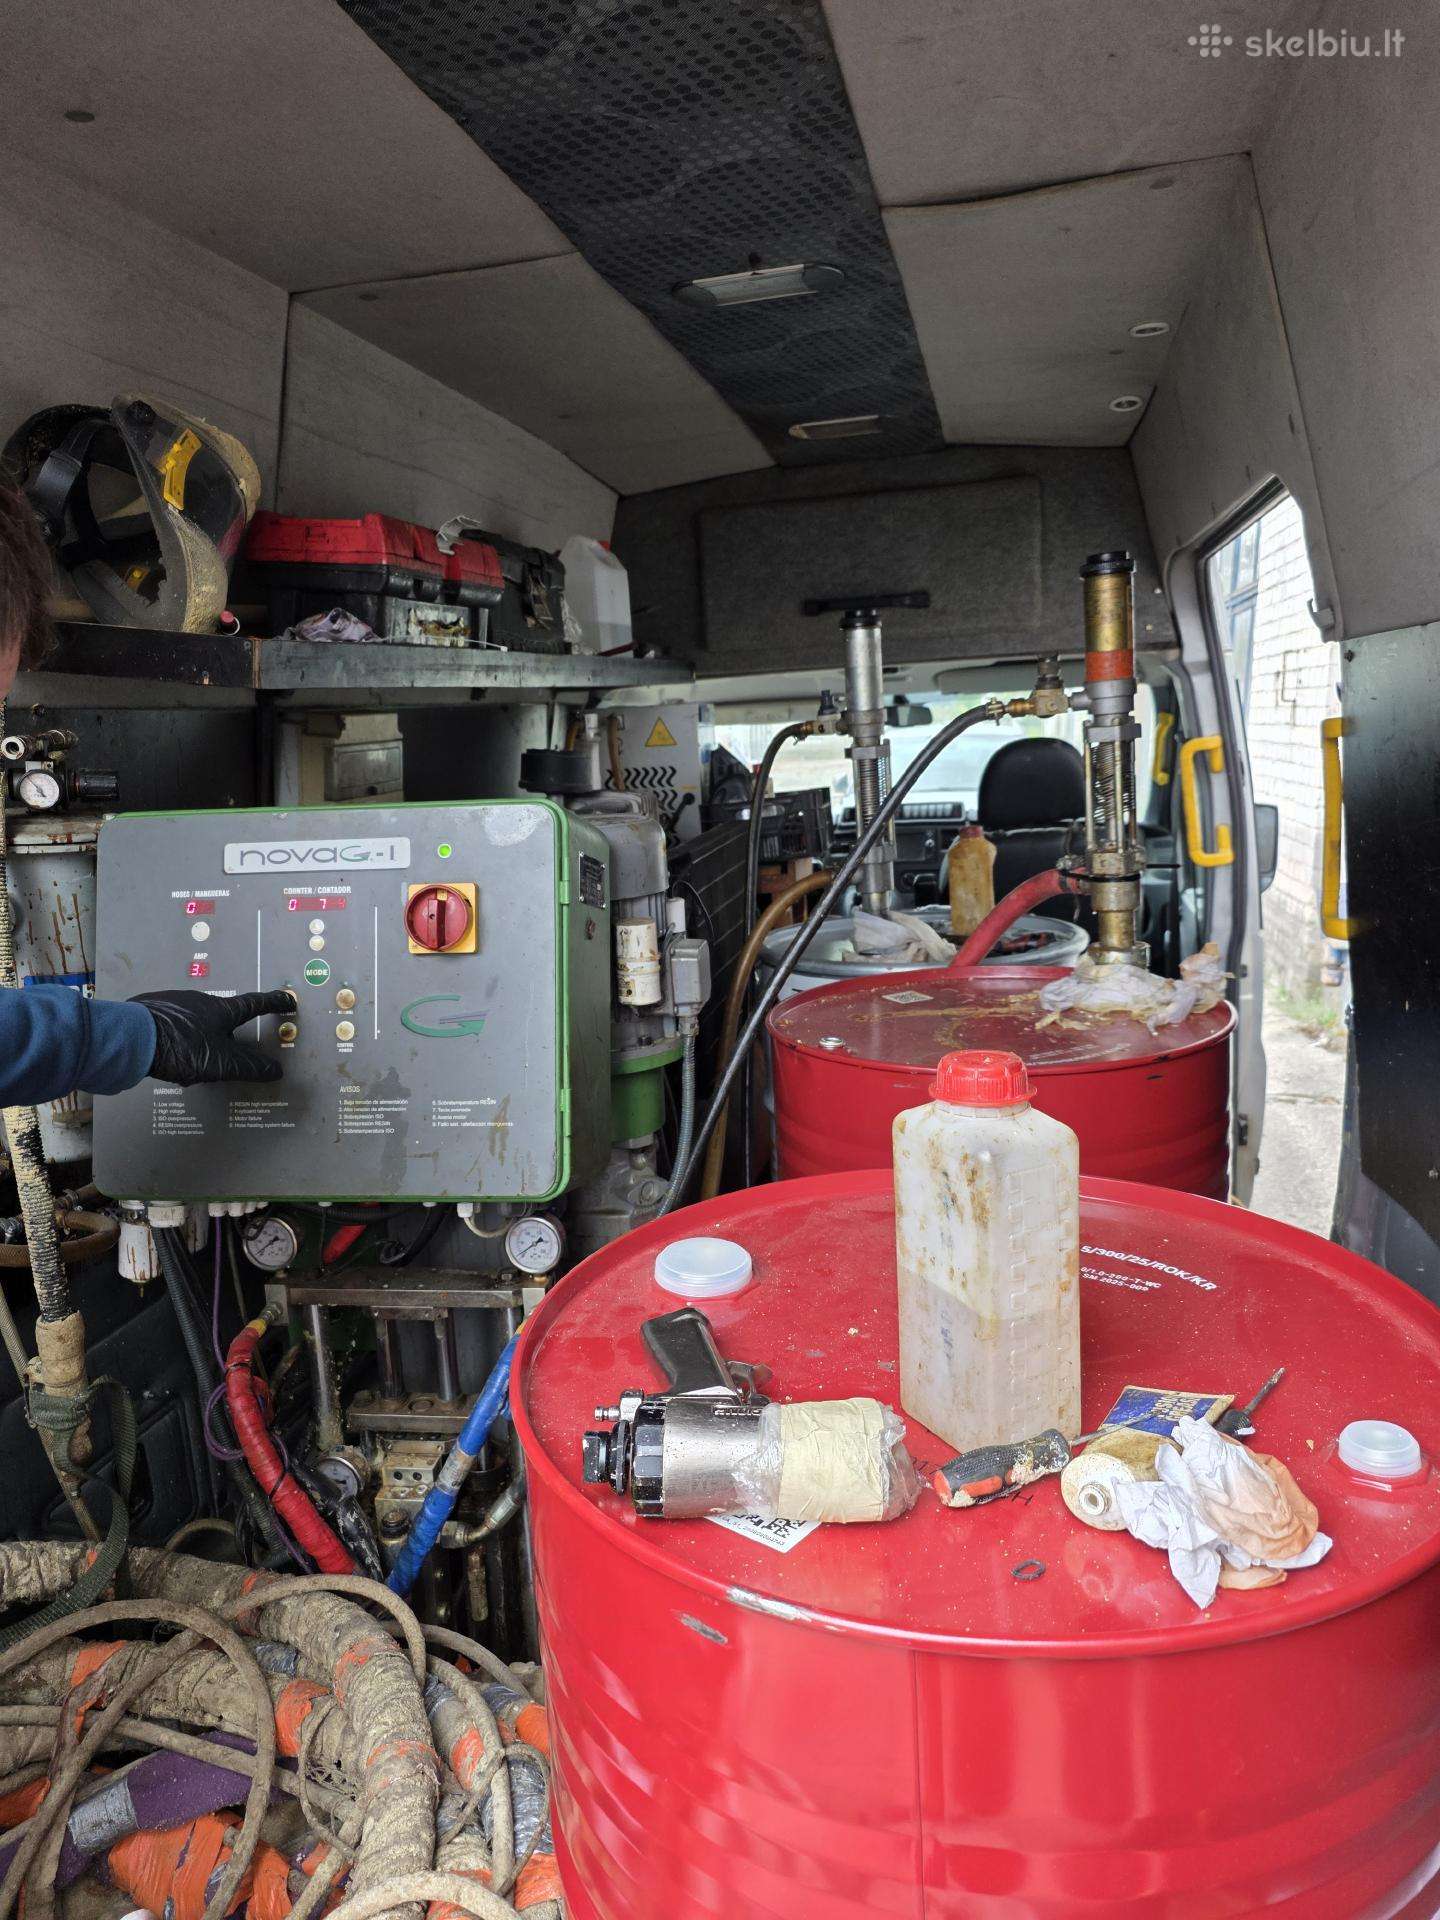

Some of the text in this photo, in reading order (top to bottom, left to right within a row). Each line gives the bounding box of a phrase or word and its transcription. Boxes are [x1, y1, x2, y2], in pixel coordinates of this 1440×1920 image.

[283, 887, 312, 895] COUNTER
[317, 886, 352, 895] CONTADOR
[193, 952, 208, 960] AMP
[339, 1085, 361, 1093] AVISOS
